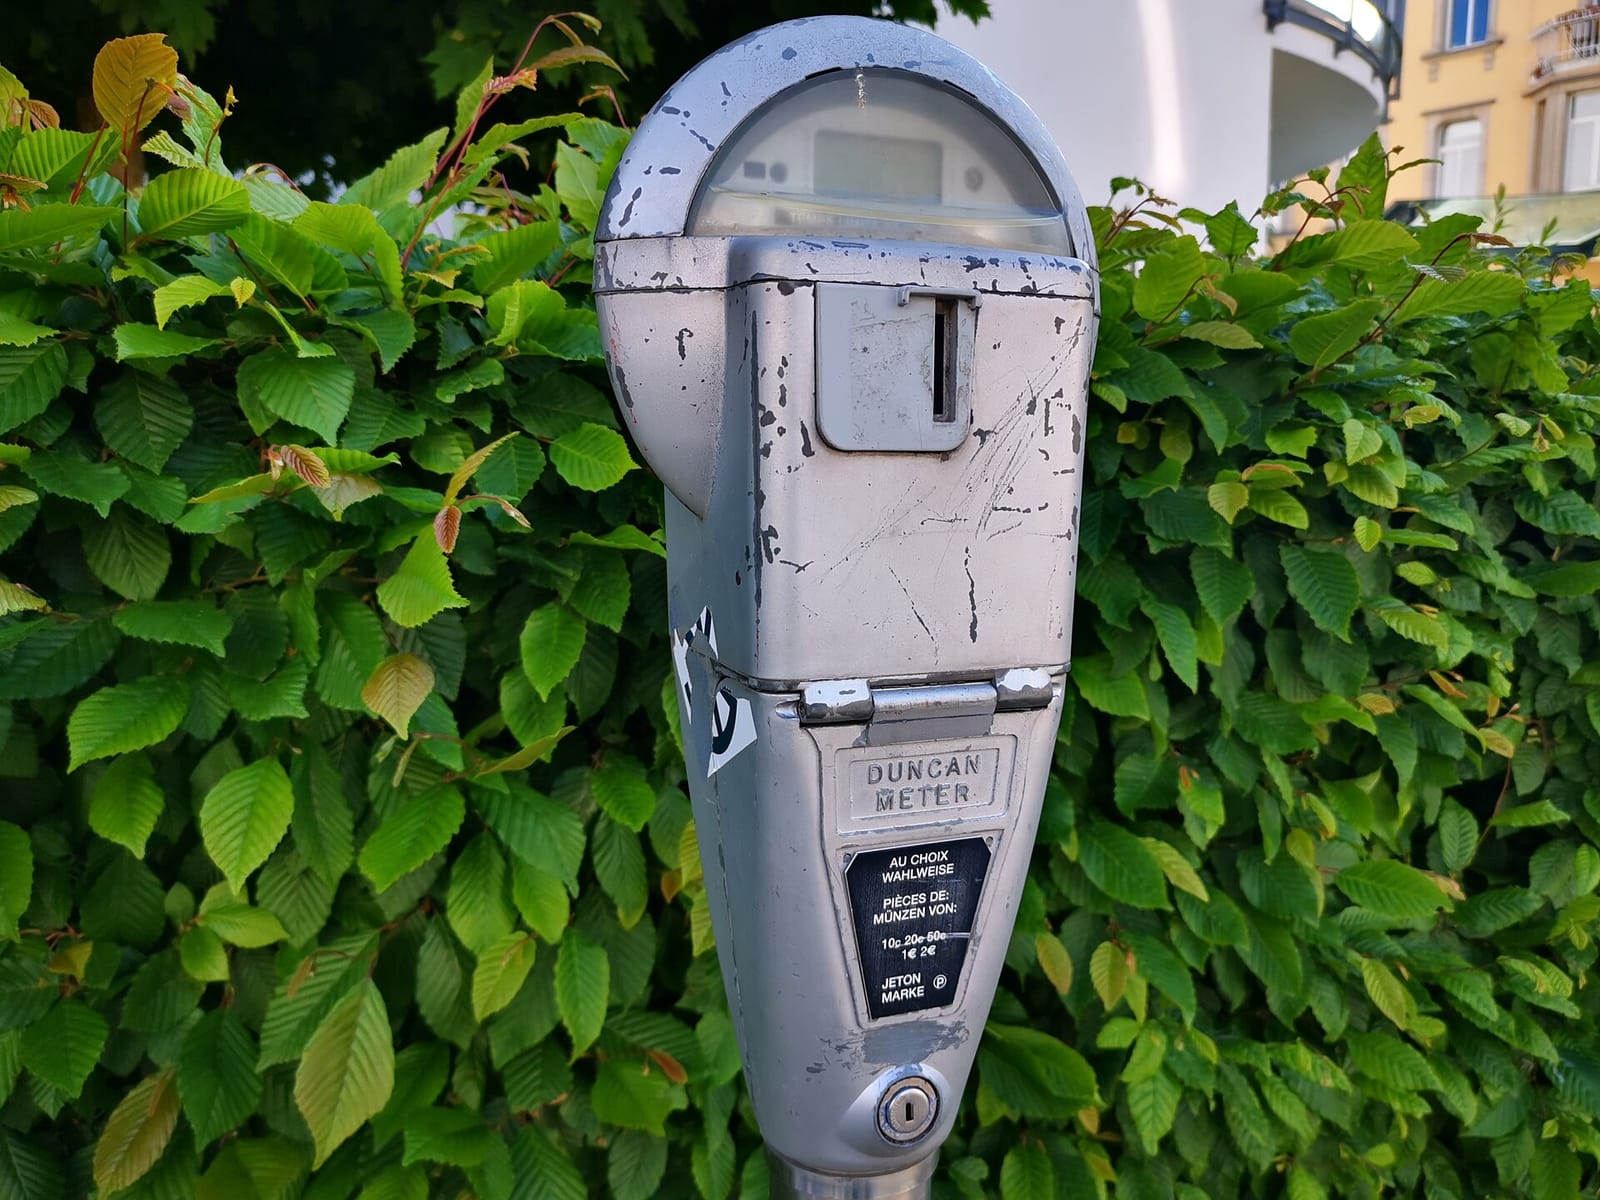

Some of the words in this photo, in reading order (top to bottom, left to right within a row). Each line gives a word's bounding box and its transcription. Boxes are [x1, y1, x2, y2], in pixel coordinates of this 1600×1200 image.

[868, 754, 980, 785] DUNCAN
[876, 783, 970, 812] METER
[889, 856, 907, 869] AU
[910, 850, 949, 865] CHOIX
[882, 863, 954, 884] WAHLWEISE
[883, 893, 926, 910] PIÈCES
[929, 890, 949, 902] DE:
[873, 909, 926, 926] MÜNZEN
[928, 903, 957, 917] VON:
[881, 972, 921, 990] JETON
[881, 986, 924, 1004] MARKE
